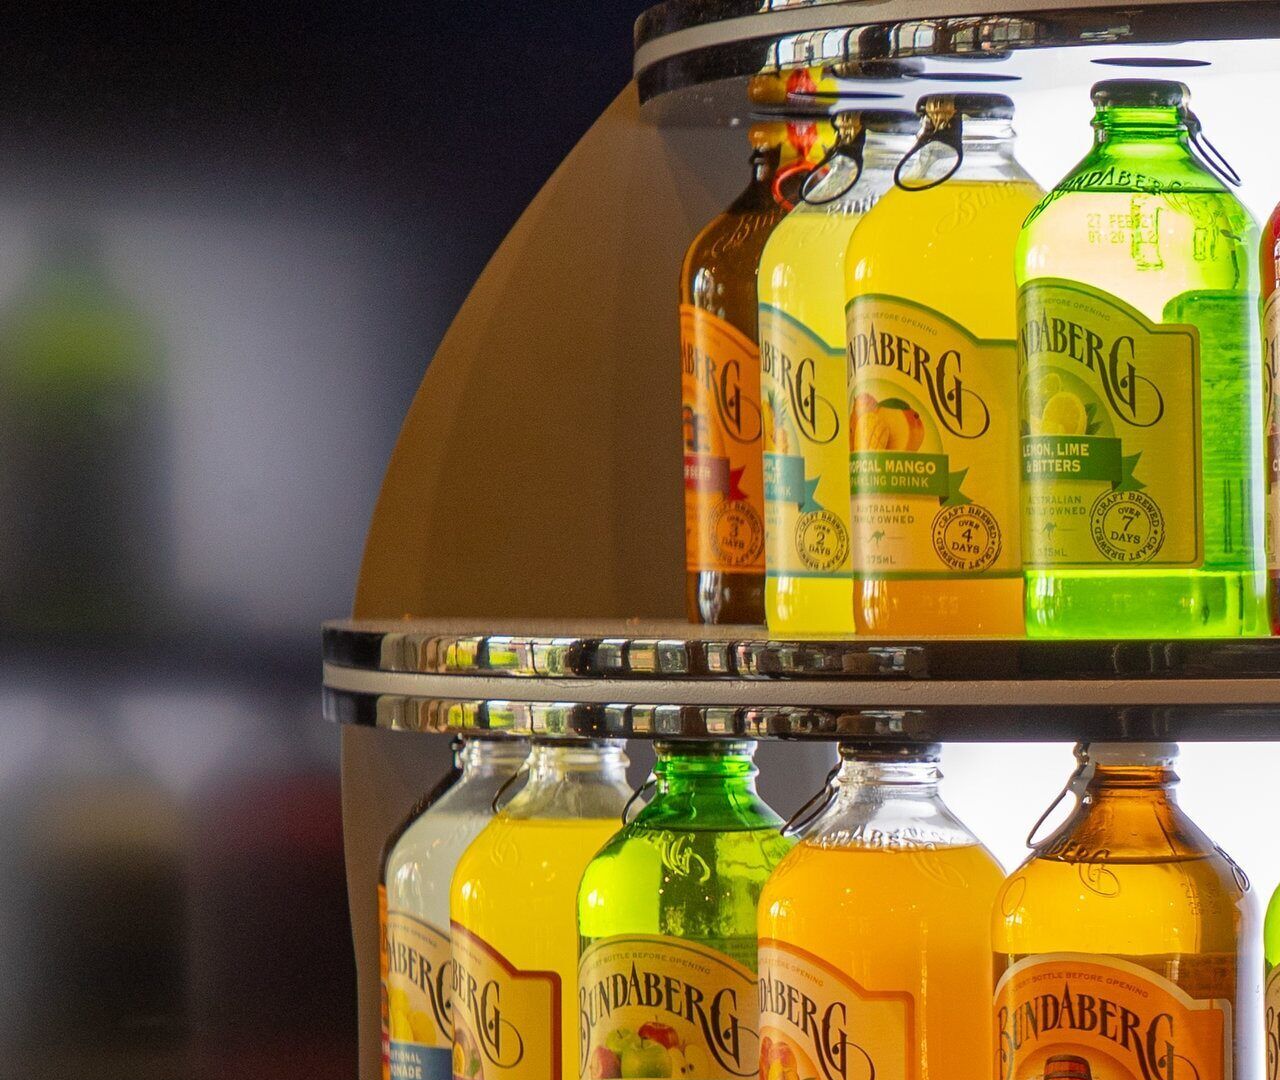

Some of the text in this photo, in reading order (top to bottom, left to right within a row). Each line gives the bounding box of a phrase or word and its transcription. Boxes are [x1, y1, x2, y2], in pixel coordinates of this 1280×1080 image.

[1058, 444, 1089, 455] LIME
[885, 462, 936, 473] MANGO
[890, 476, 929, 487] DRINK
[1118, 507, 1141, 519] OVER
[1122, 515, 1135, 531] 7
[1111, 531, 1141, 544] DAYS
